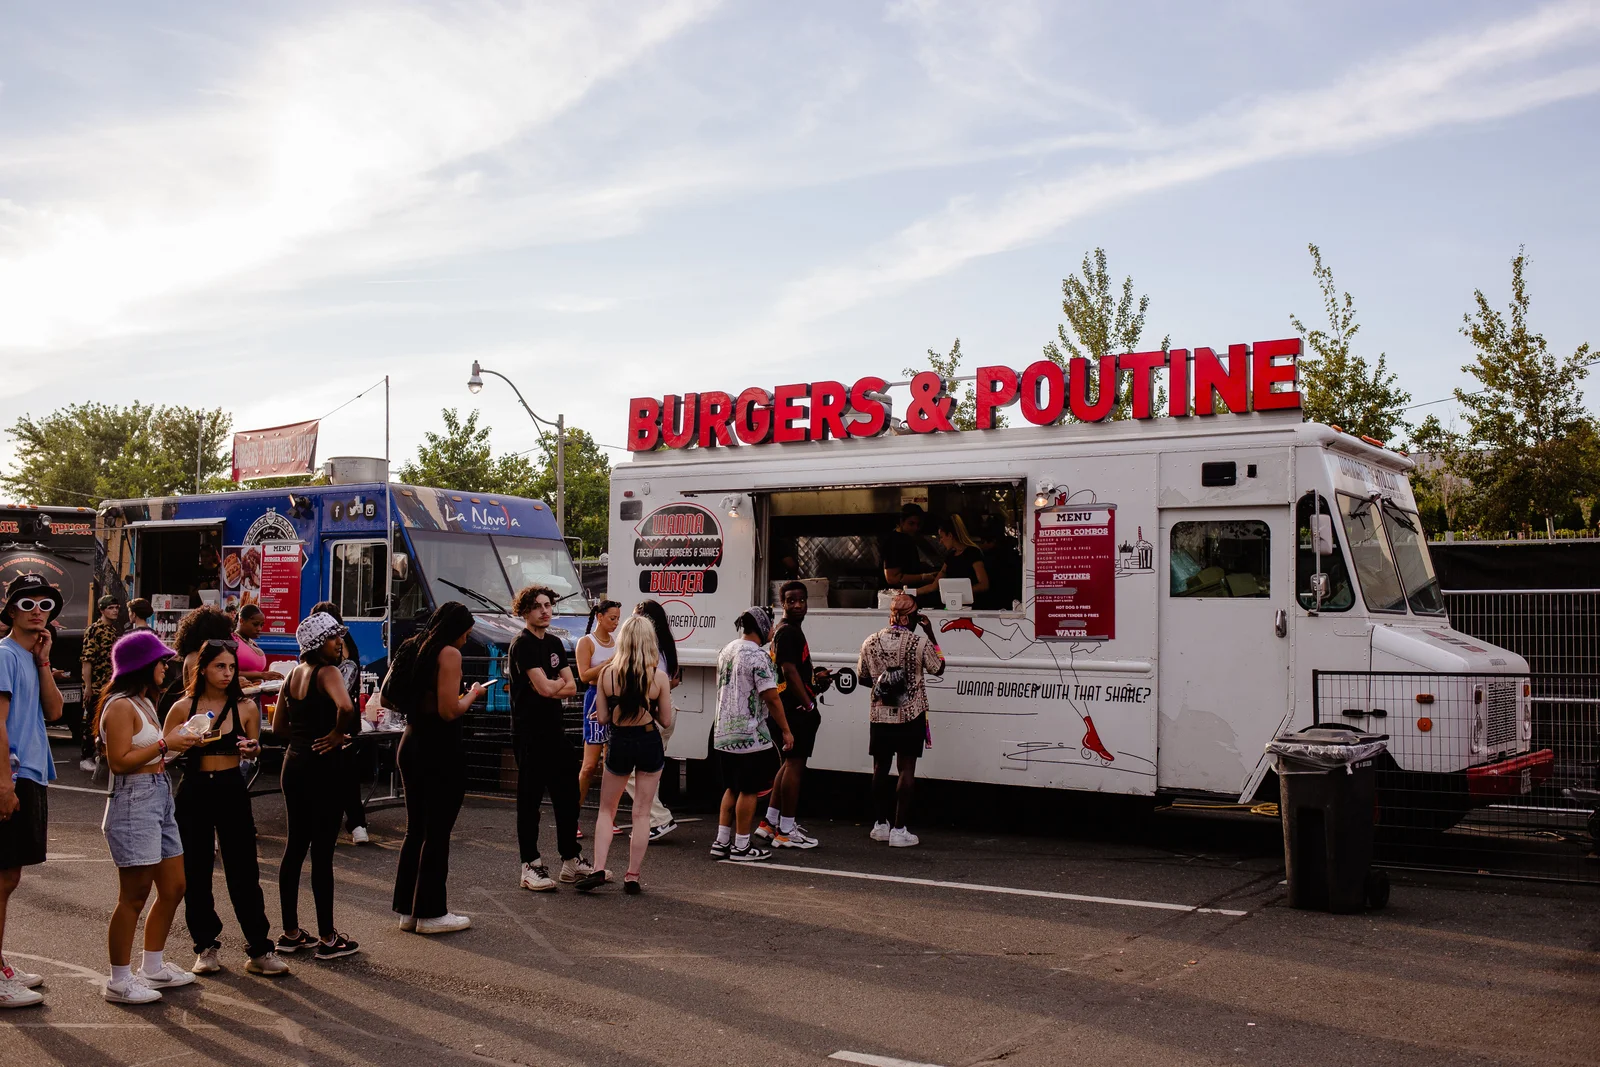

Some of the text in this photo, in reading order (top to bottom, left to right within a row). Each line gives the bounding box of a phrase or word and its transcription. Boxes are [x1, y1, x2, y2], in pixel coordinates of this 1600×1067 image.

[627, 338, 1304, 452] BURGERS & POUTINE
[445, 504, 467, 522] La
[1056, 513, 1092, 522] MENU
[49, 523, 92, 535] TRUCK
[653, 513, 704, 534] WANNA
[1039, 528, 1109, 537] BURGER COMBOS
[650, 571, 704, 596] BURGER
[667, 615, 716, 628] URGERTO.COM
[1055, 629, 1087, 637] WATER
[957, 680, 993, 696] WANNA
[997, 681, 1038, 699] BURGER
[1041, 683, 1070, 700] WITH
[1074, 684, 1101, 701] THAT
